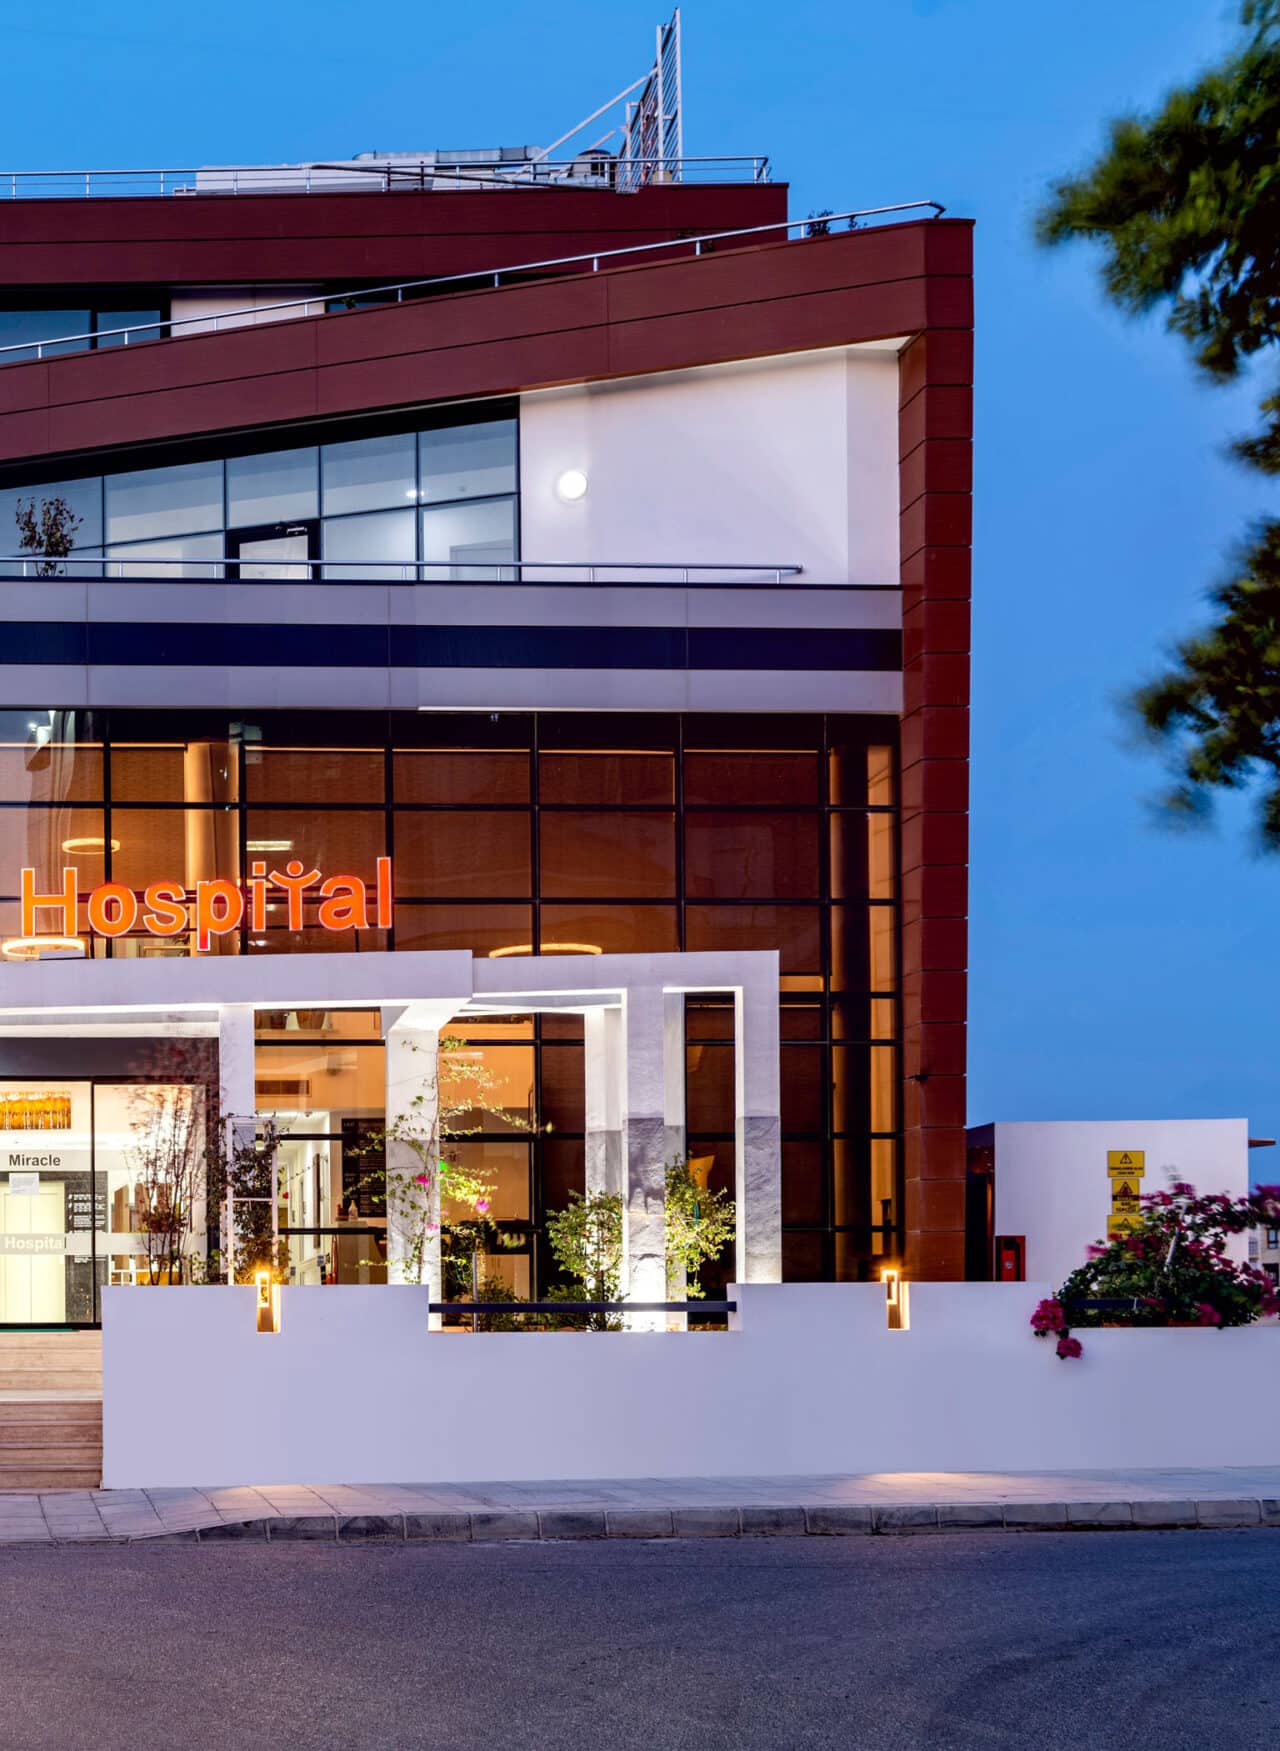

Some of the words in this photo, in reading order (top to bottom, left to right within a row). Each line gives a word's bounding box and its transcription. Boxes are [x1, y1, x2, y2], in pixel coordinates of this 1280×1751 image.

[20, 856, 393, 951] Hospital
[8, 1154, 61, 1167] Miracle
[4, 1236, 67, 1253] Hospital
